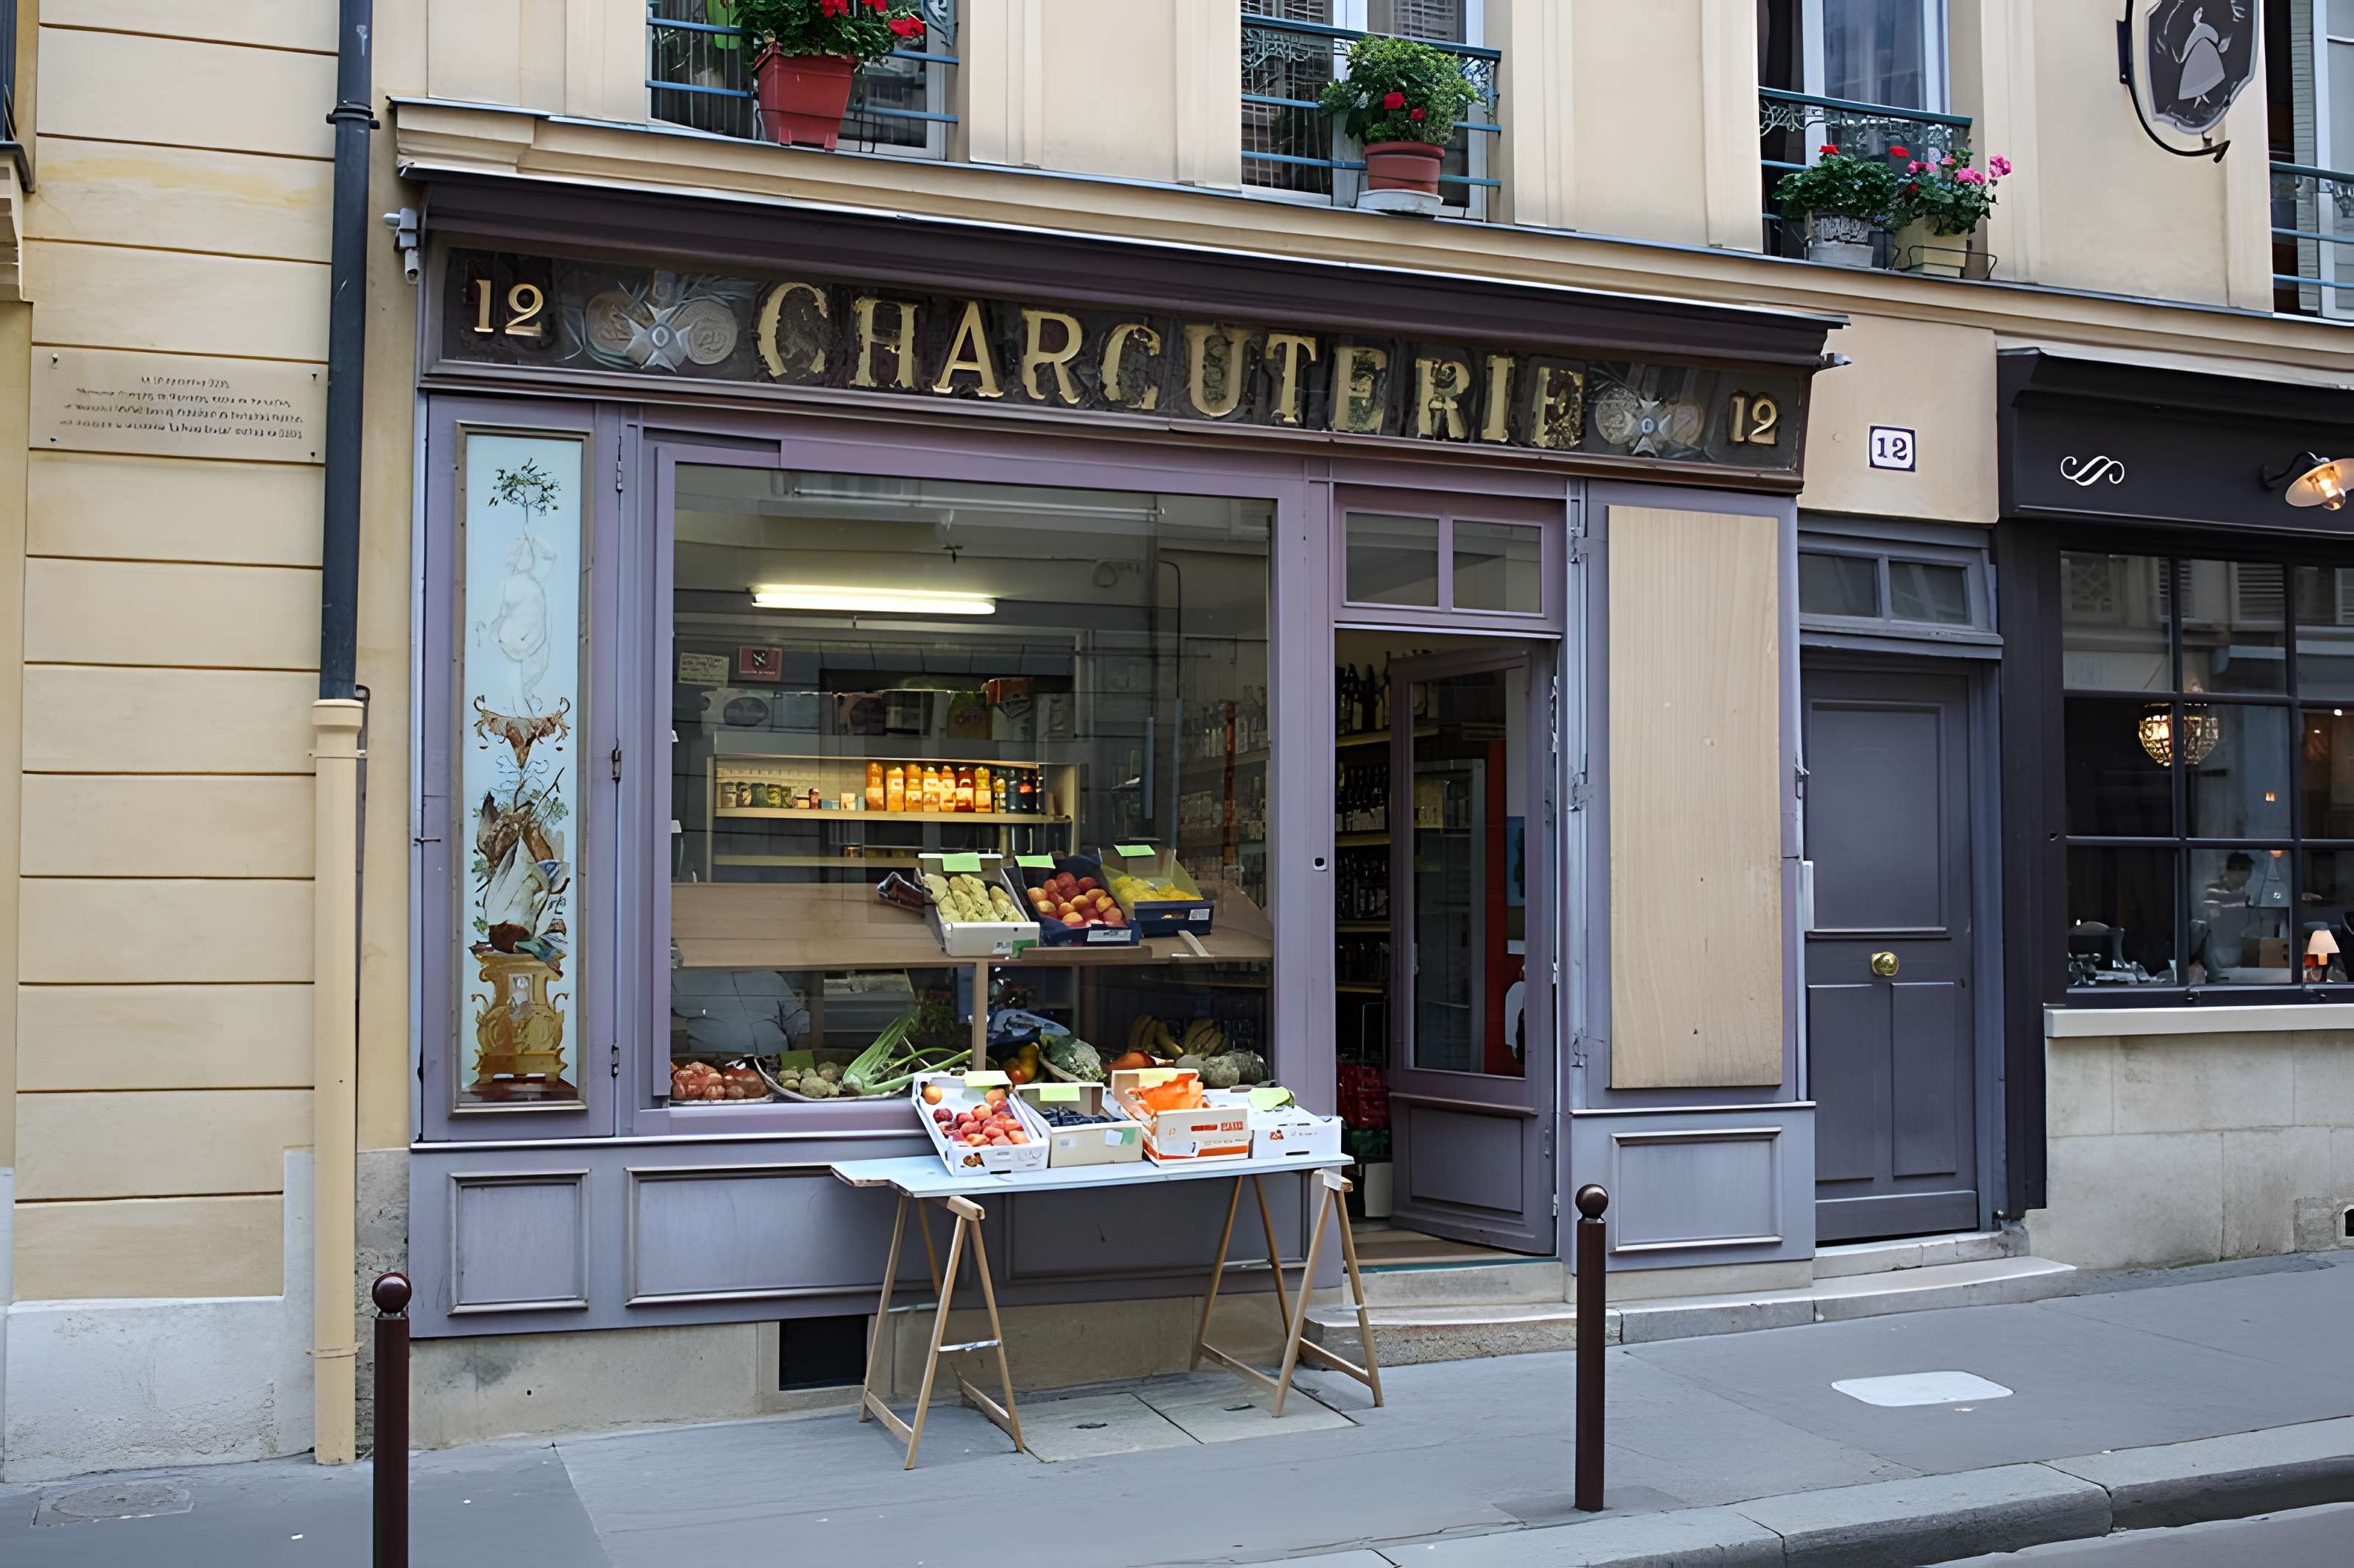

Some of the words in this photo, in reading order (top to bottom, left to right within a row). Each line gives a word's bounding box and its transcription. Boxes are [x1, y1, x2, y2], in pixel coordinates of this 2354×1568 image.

[473, 279, 544, 337] 12
[757, 281, 1585, 449] CHARCUTERIE
[1729, 395, 1777, 445] 12
[1876, 436, 1908, 461] 12
